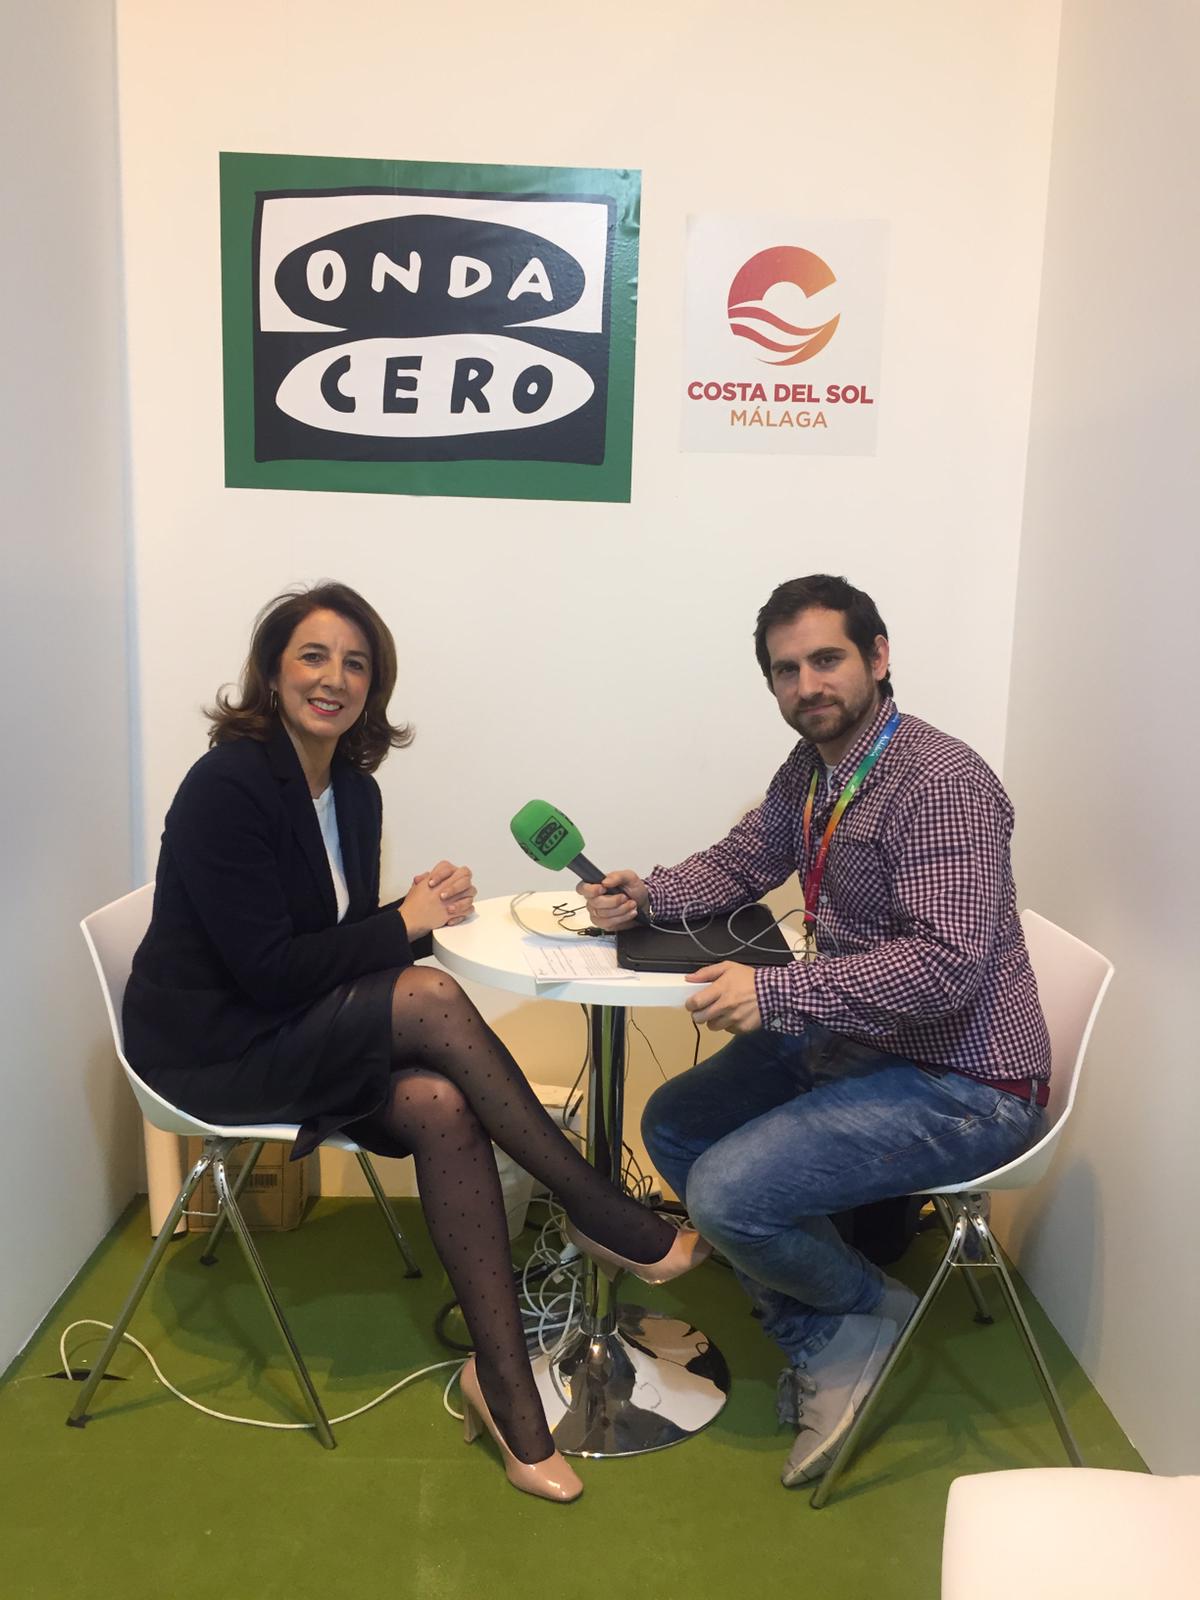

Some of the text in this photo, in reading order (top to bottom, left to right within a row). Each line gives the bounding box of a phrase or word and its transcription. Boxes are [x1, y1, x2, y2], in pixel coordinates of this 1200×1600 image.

[306, 249, 554, 302] ONDA
[320, 354, 554, 414] CERO
[687, 381, 874, 404] COSTA DEL SOL
[730, 406, 828, 428] MÁLAGA
